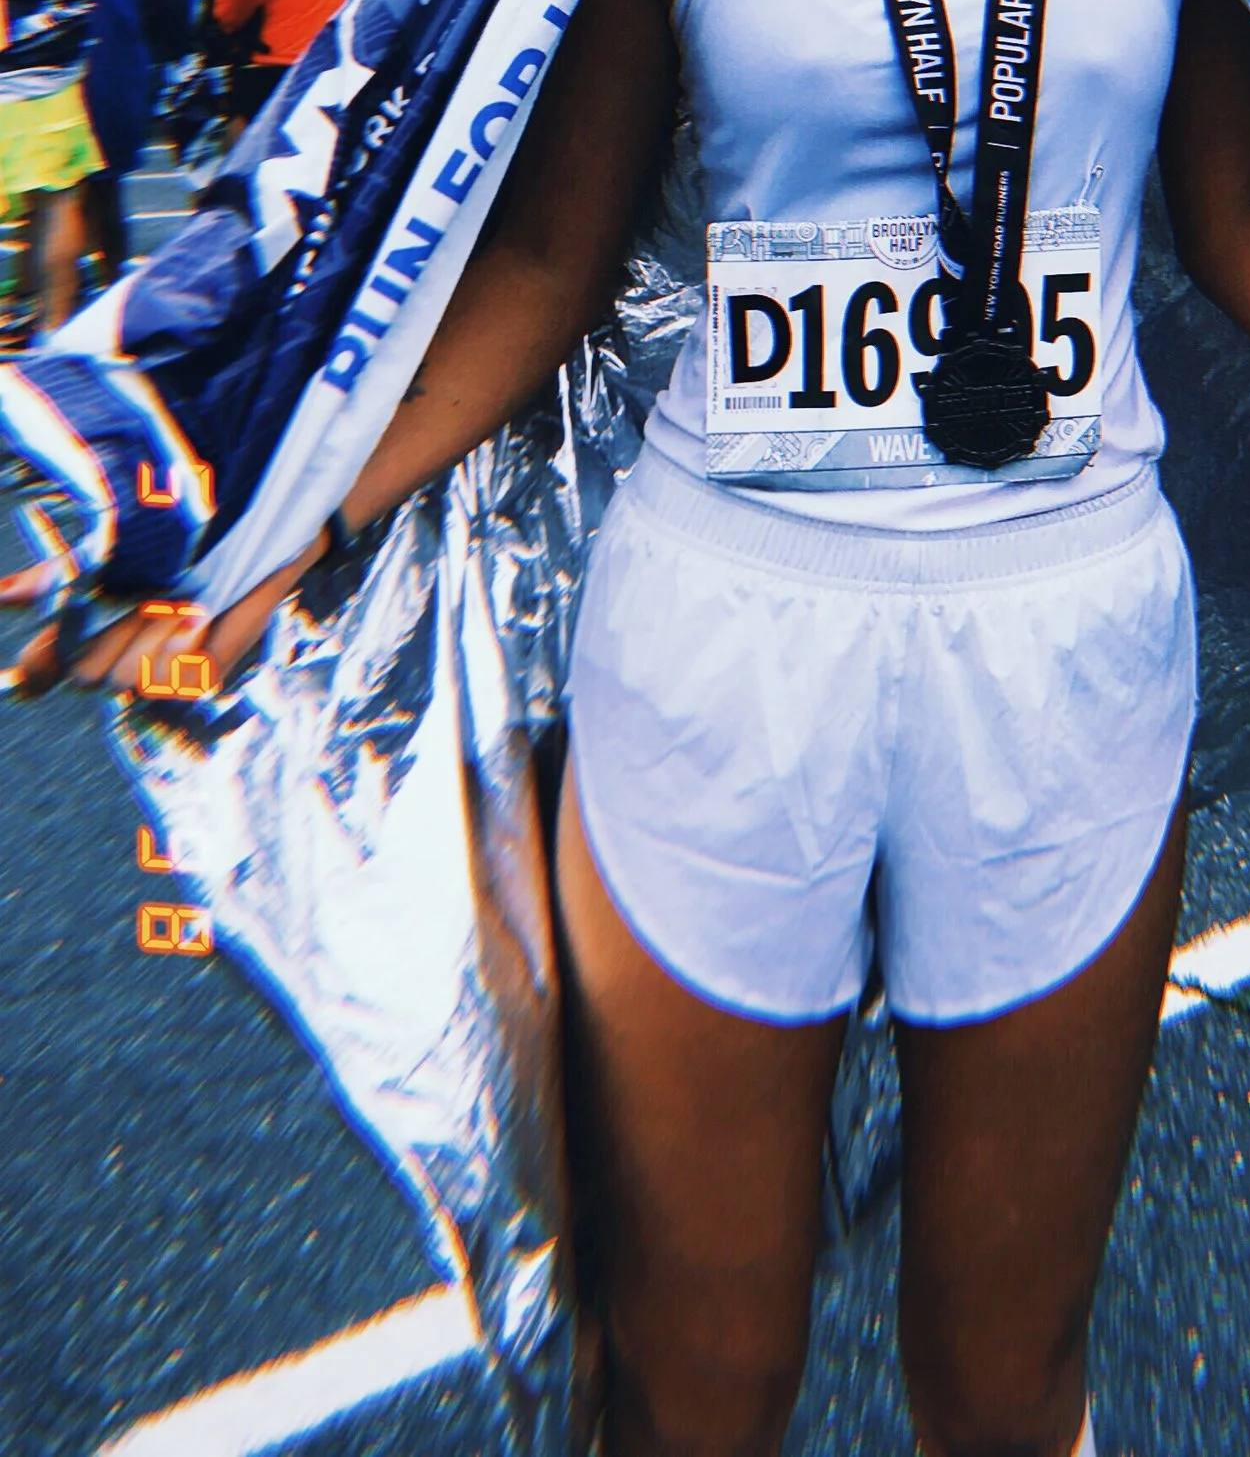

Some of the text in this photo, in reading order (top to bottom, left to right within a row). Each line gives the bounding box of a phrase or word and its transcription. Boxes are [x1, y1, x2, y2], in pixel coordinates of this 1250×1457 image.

[906, 32, 947, 105] HALF
[996, 170, 1011, 223] RUNNERS
[872, 221, 937, 238] BROOKLYN
[890, 237, 923, 252] HALF
[993, 224, 1005, 257] ROAD
[988, 258, 1003, 289] YORK
[868, 435, 931, 463] WAVE
